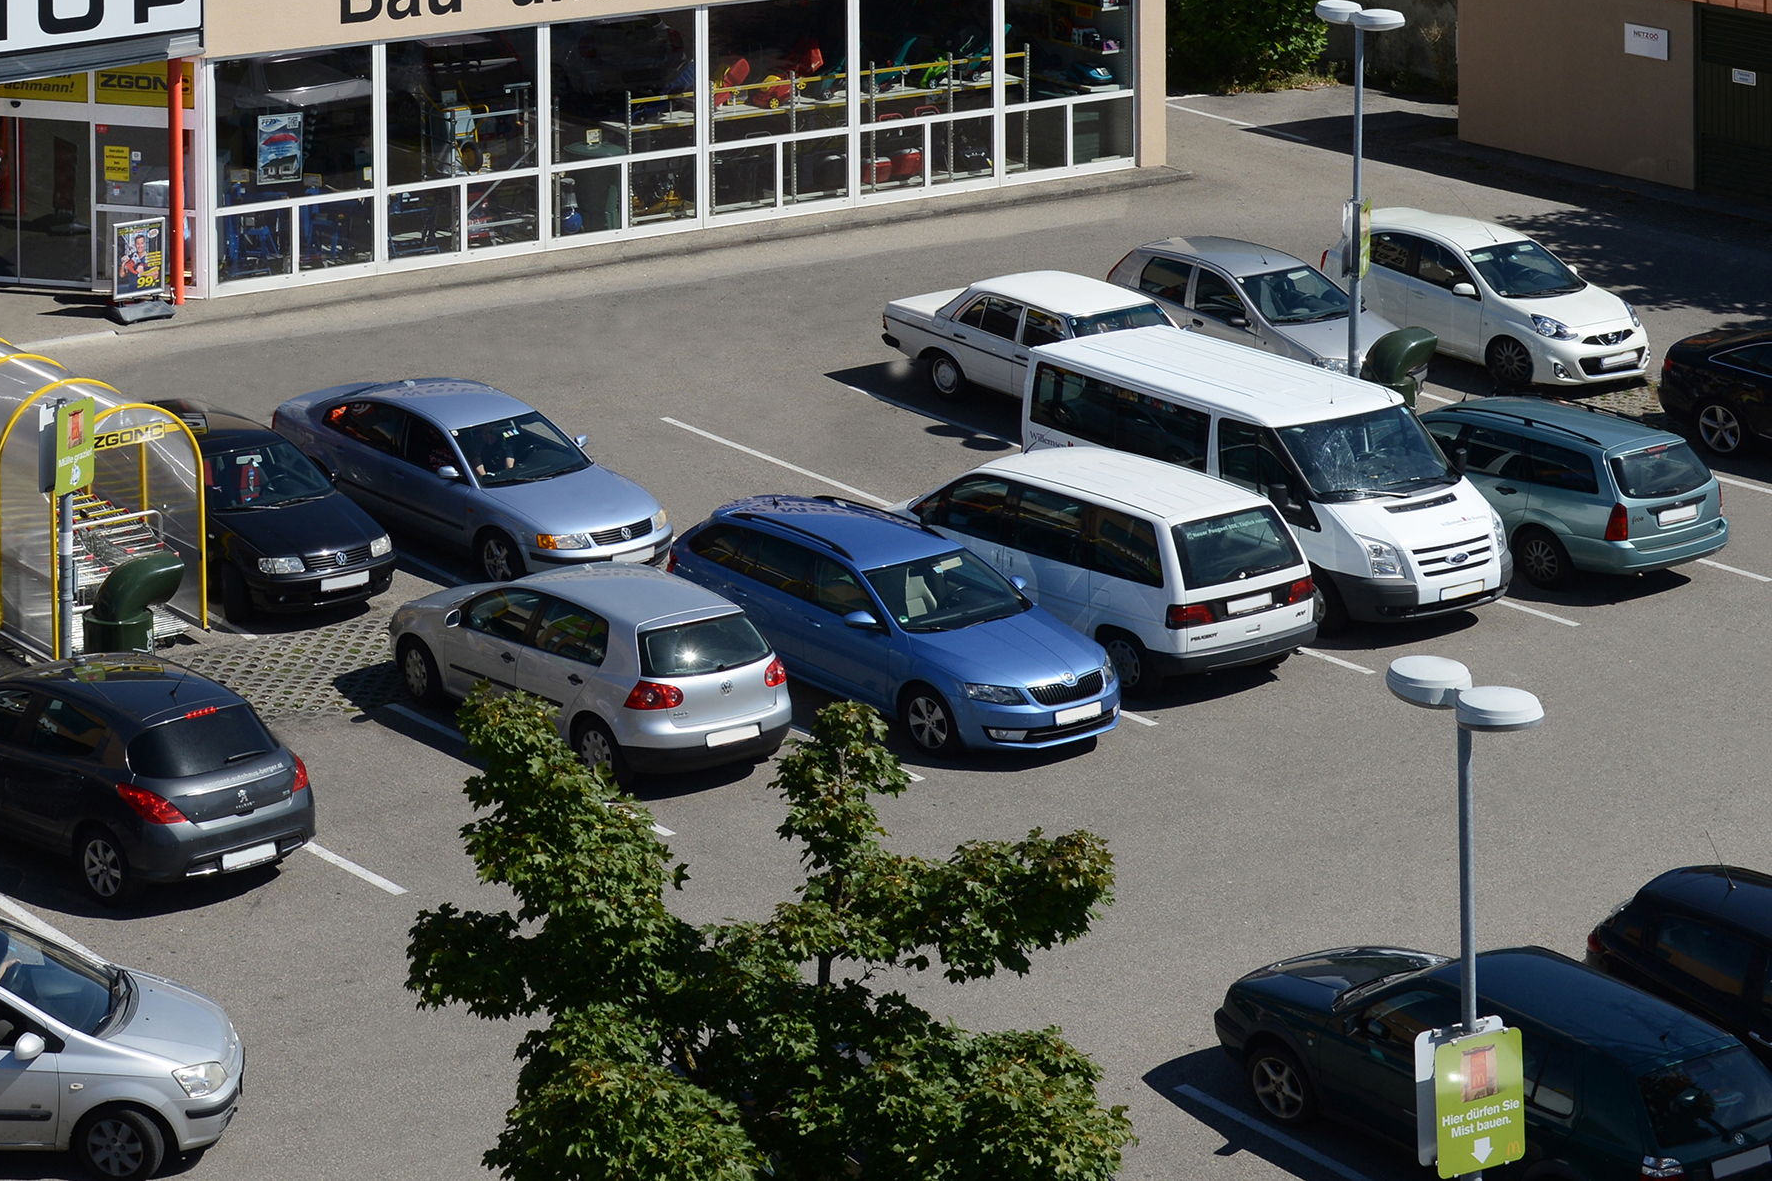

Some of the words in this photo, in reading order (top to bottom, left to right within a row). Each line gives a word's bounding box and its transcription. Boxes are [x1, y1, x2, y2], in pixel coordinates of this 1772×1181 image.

[137, 276, 160, 289] 99,-
[58, 455, 77, 468] Mülle
[77, 447, 93, 463] grazie!
[1208, 525, 1228, 535] Peugeot
[1190, 631, 1219, 643] PEUGEOT
[1442, 1113, 1464, 1127] Hier
[1466, 1104, 1500, 1121] dürfen
[1502, 1099, 1520, 1112] Sie
[1451, 1124, 1475, 1138] Mist
[1477, 1116, 1512, 1132] bauen.
